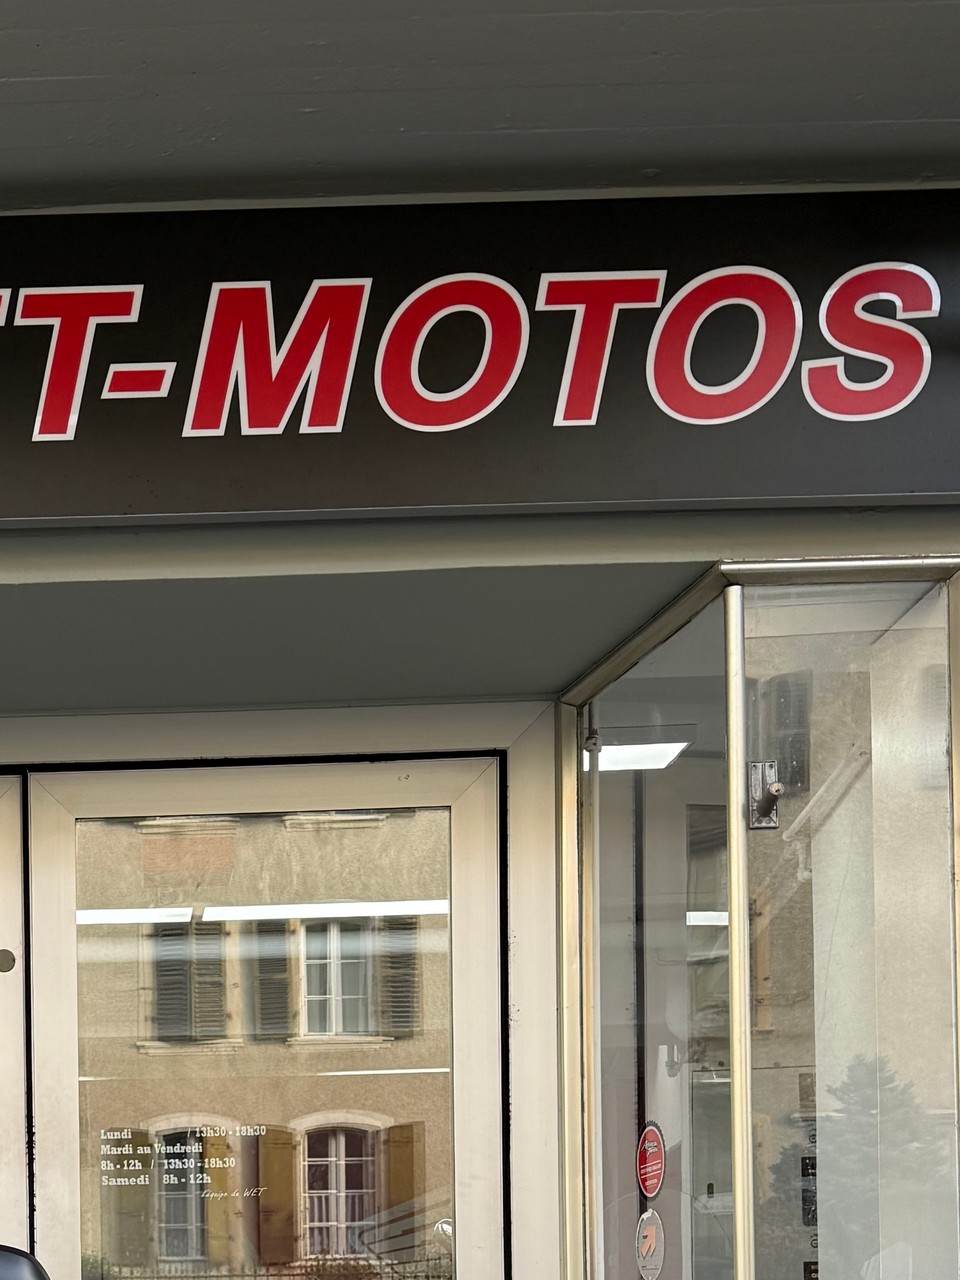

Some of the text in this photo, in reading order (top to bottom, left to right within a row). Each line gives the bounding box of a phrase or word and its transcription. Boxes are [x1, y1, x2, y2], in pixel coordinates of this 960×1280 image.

[100, 1129, 132, 1140] Lundi
[195, 1126, 226, 1137] 13h30
[235, 1125, 266, 1136] 18h30
[100, 1143, 203, 1155] Mardi au Vendredi
[100, 1160, 115, 1171] 8h
[123, 1159, 143, 1170] 12h
[163, 1158, 195, 1169] 13h30
[204, 1157, 236, 1168] 18h30
[101, 1174, 150, 1186] Samedi
[162, 1174, 179, 1184] 8h
[189, 1173, 212, 1184] 12h
[243, 1187, 268, 1197] WET
